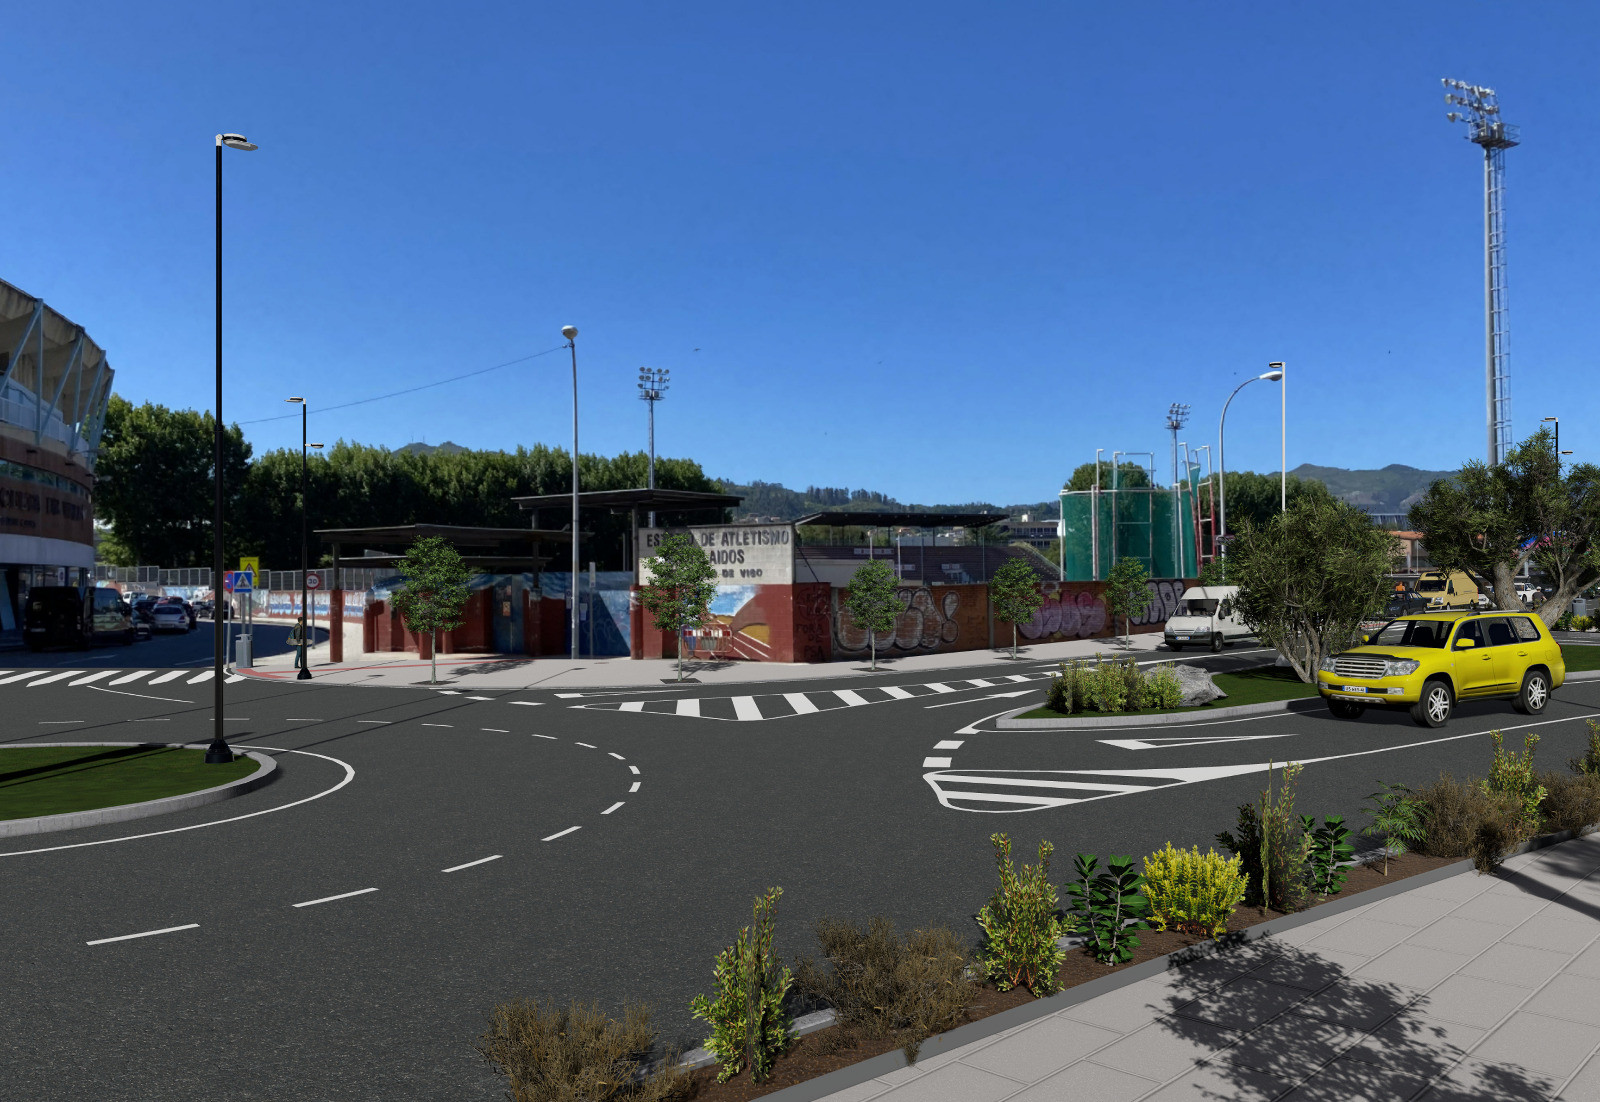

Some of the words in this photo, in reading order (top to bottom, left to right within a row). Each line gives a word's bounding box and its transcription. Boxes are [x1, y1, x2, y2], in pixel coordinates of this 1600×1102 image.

[701, 532, 715, 547] DE
[721, 530, 789, 546] ATLETISMO
[709, 549, 745, 565] AIDOS
[721, 569, 735, 578] DE
